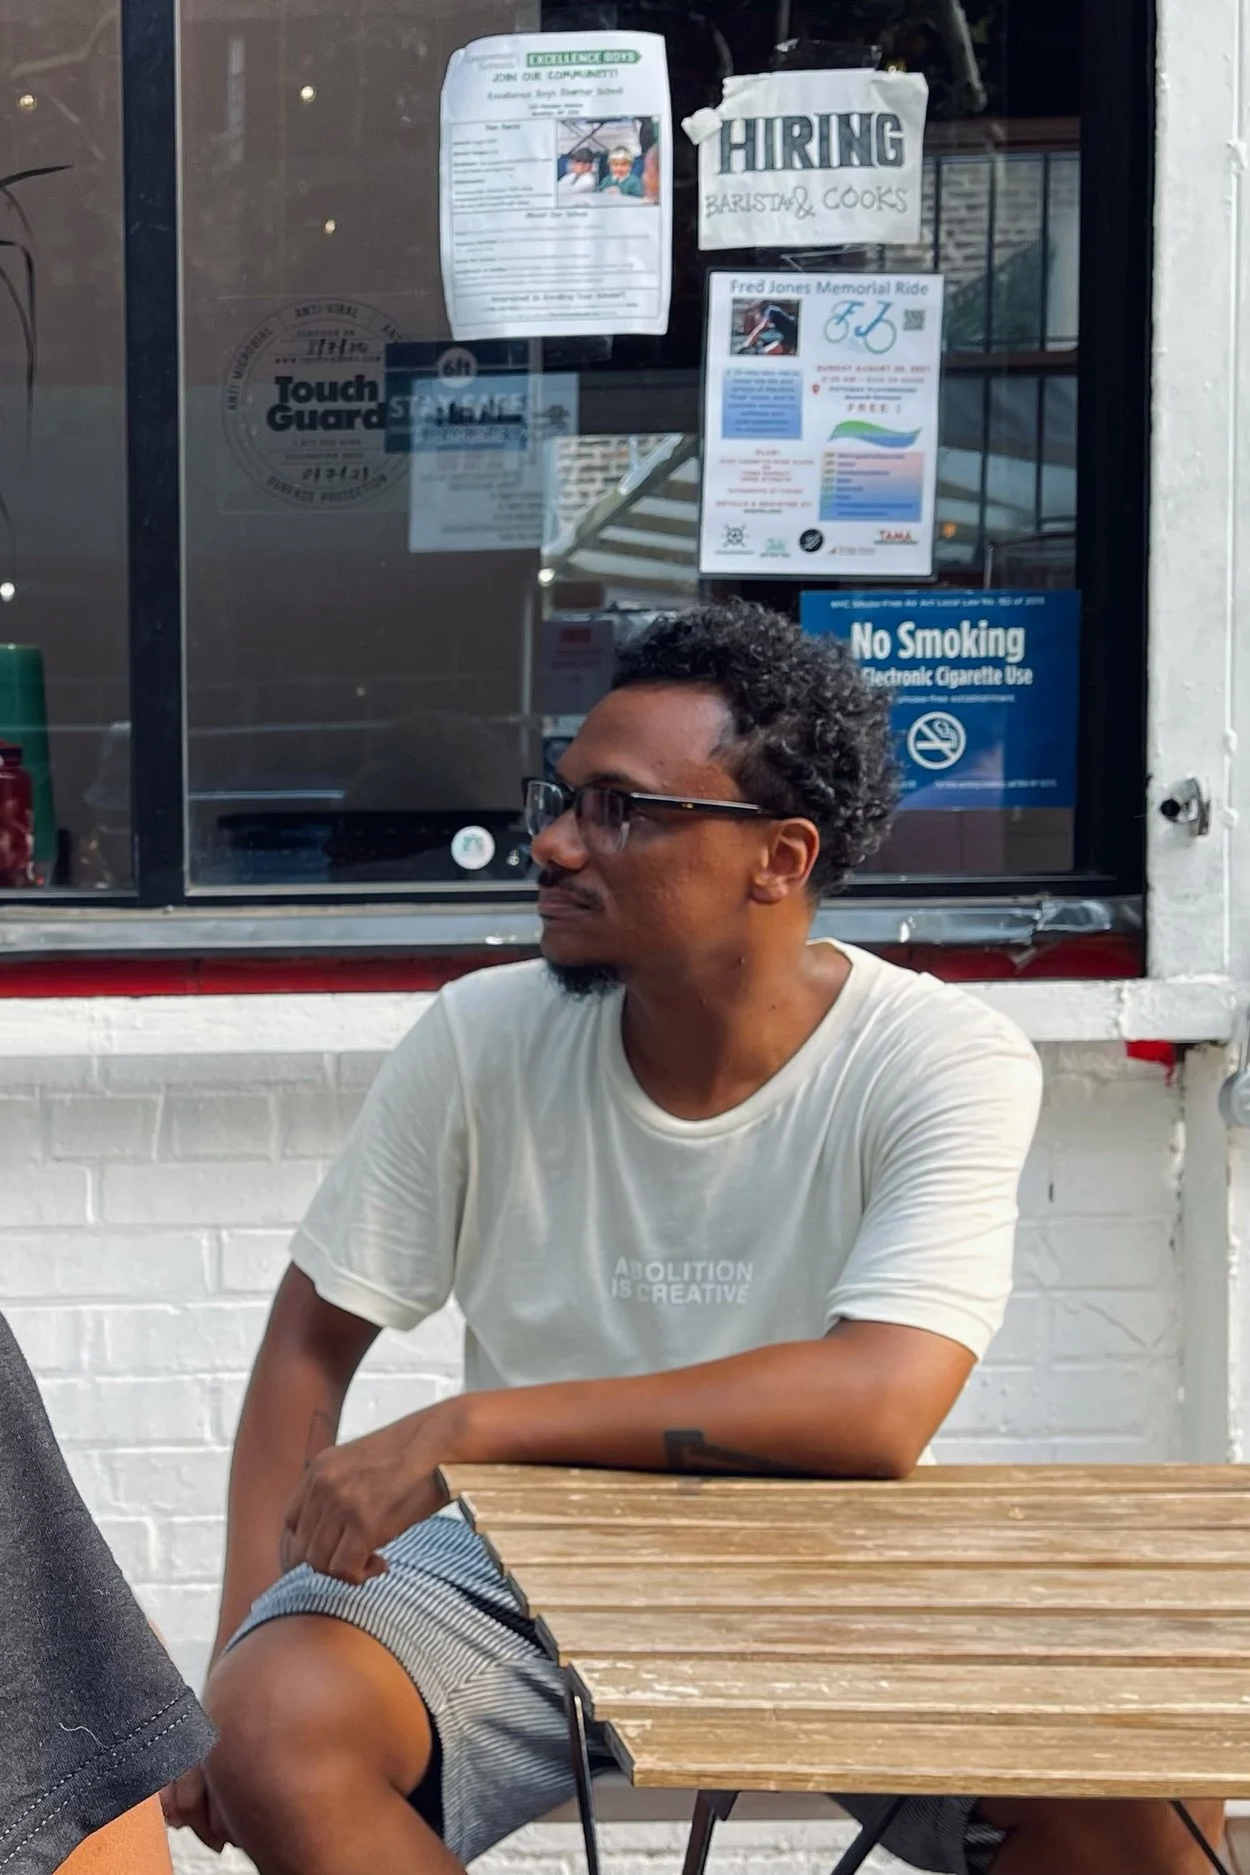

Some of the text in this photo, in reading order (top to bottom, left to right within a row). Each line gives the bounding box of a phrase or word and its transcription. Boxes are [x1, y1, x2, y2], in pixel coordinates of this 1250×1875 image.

[528, 52, 601, 66] EXCELLENCE
[492, 72, 517, 83] JOIN
[596, 86, 624, 96] School
[718, 112, 904, 175] HIRING
[823, 185, 909, 214] COOKS
[730, 279, 929, 296] Fred Jones Memorial Ride
[442, 357, 471, 376] 6ft
[275, 374, 379, 404] Touch
[266, 403, 386, 432] Guard
[851, 619, 1025, 662] No Smoking
[935, 665, 1002, 689] Cigarette
[1004, 666, 1033, 686] Use
[614, 1256, 753, 1283] ABOLITION
[611, 1279, 751, 1305] IS CREATIVE
